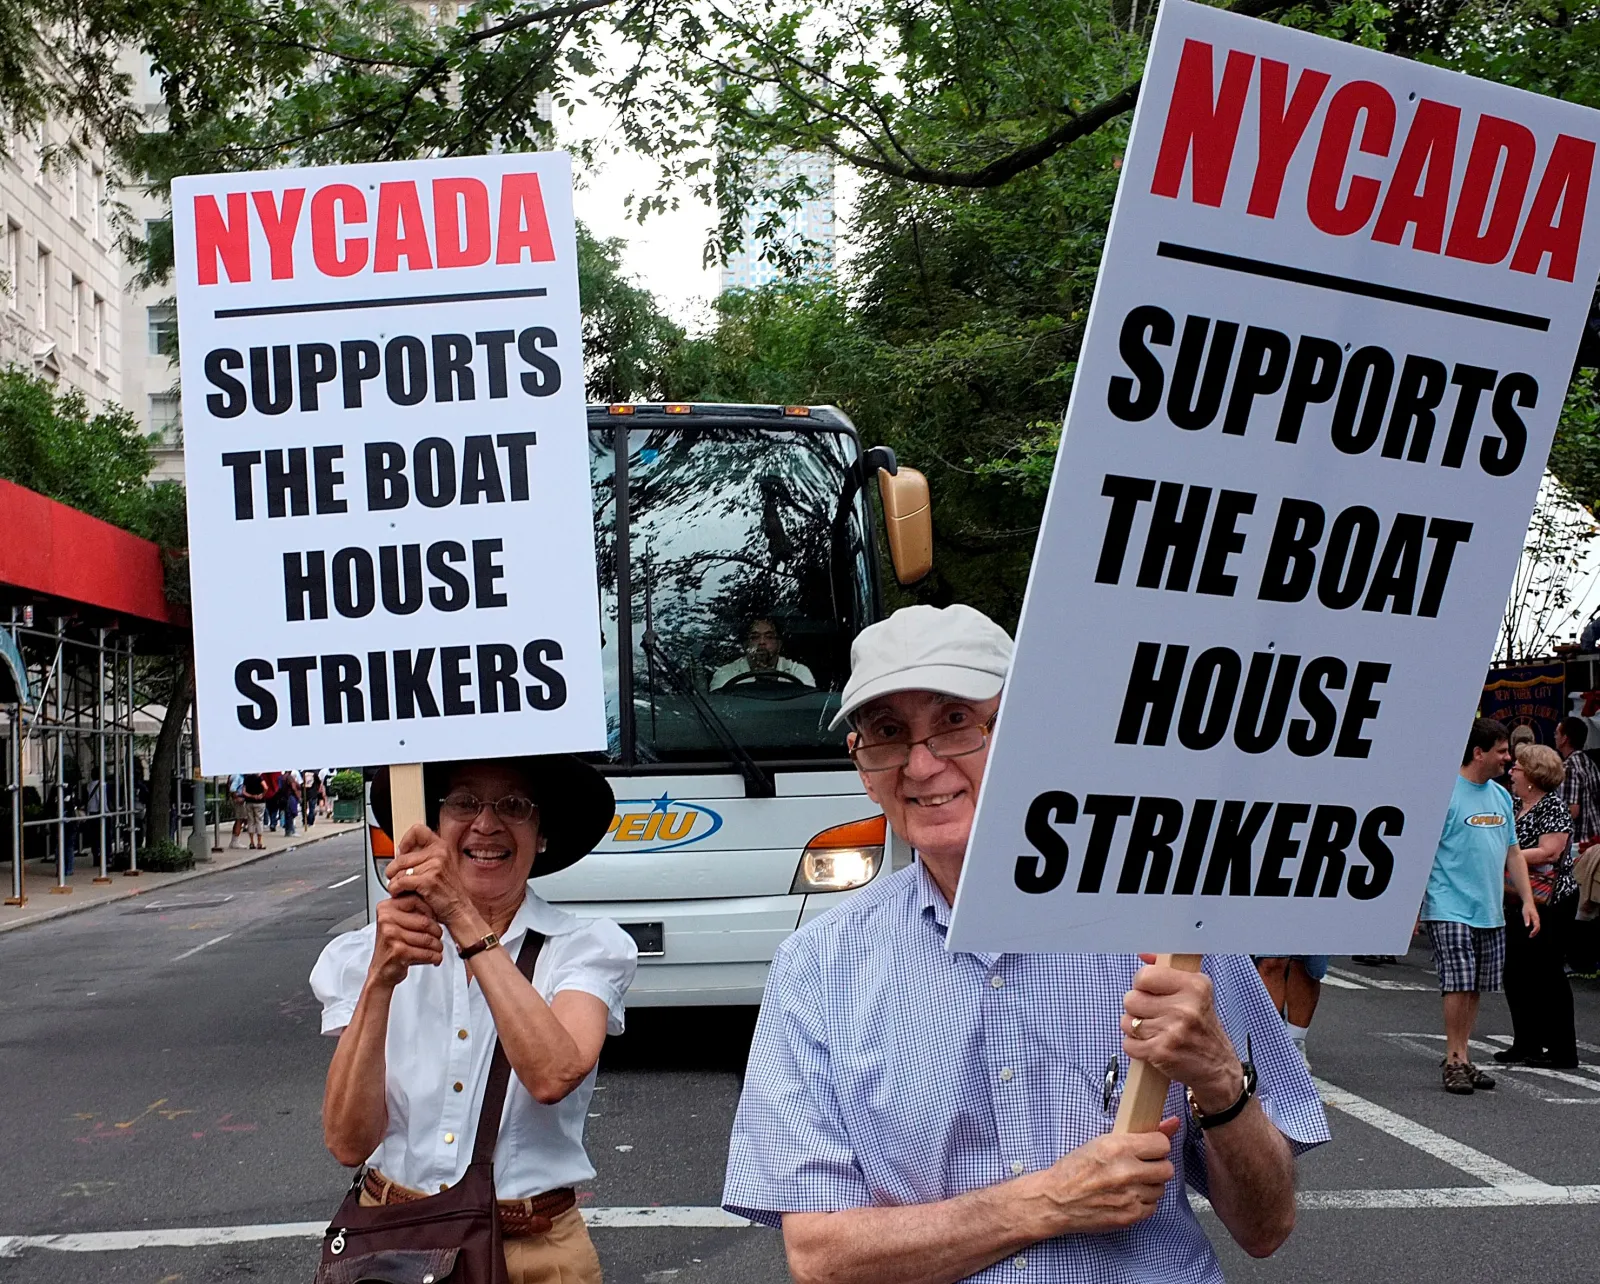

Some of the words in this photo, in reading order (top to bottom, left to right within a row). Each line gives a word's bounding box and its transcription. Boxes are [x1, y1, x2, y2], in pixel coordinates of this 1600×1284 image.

[1150, 38, 1596, 283] NYCADA
[193, 172, 556, 286] NYCADA
[204, 326, 562, 419] SUPPORTS
[1107, 305, 1539, 477] SUPPORTS
[222, 444, 348, 521] THE
[364, 431, 537, 512] BOAT
[283, 538, 508, 622] HOUSE
[1094, 473, 1258, 597] THE
[1257, 497, 1474, 619] BOAT
[234, 638, 567, 731] STRIKERS
[1114, 641, 1392, 759] HOUSE
[1534, 686, 1553, 699] CITY
[1014, 790, 1405, 901] STRIKERS
